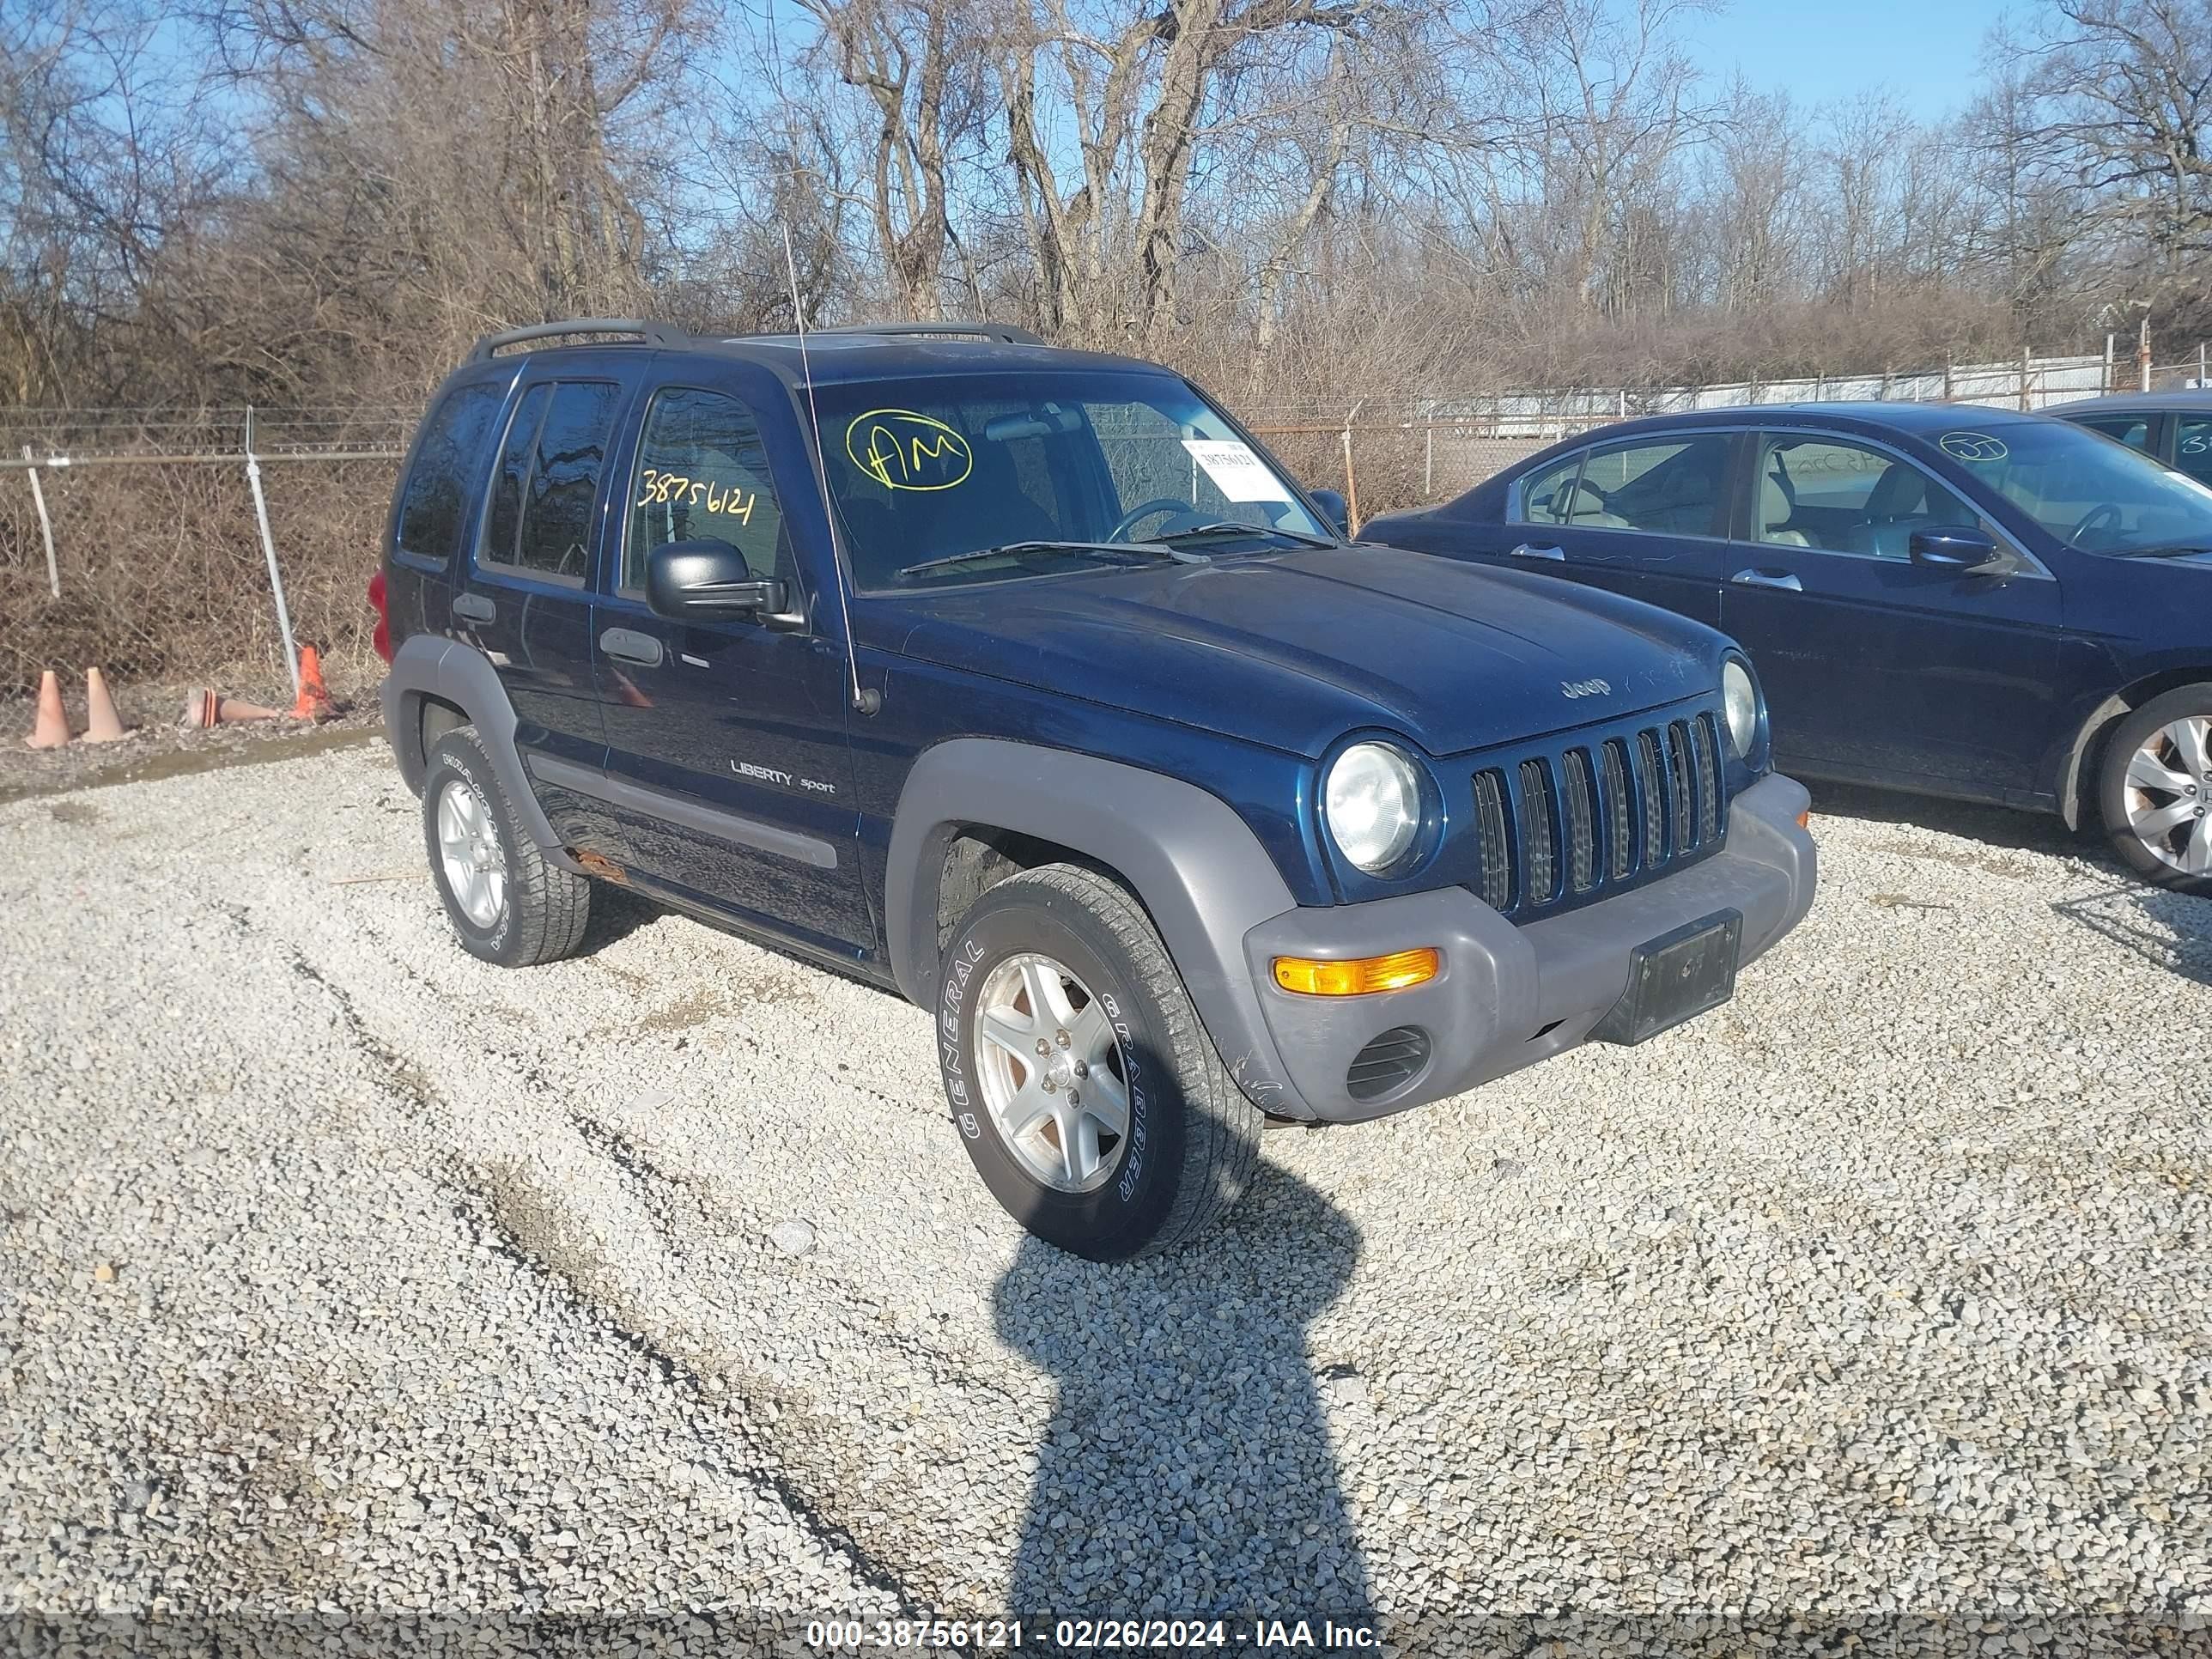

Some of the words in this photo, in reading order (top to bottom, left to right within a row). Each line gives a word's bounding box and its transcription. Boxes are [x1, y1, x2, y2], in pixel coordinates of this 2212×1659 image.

[867, 425, 965, 489] AM
[1200, 453, 1255, 466] 38756121
[637, 470, 755, 526] 38756121
[1560, 678, 1611, 699] Jeep
[730, 759, 793, 786] LIBERTY
[800, 778, 836, 793] sport
[942, 940, 985, 1139] GENERAL
[1102, 993, 1146, 1202] GRABBER
